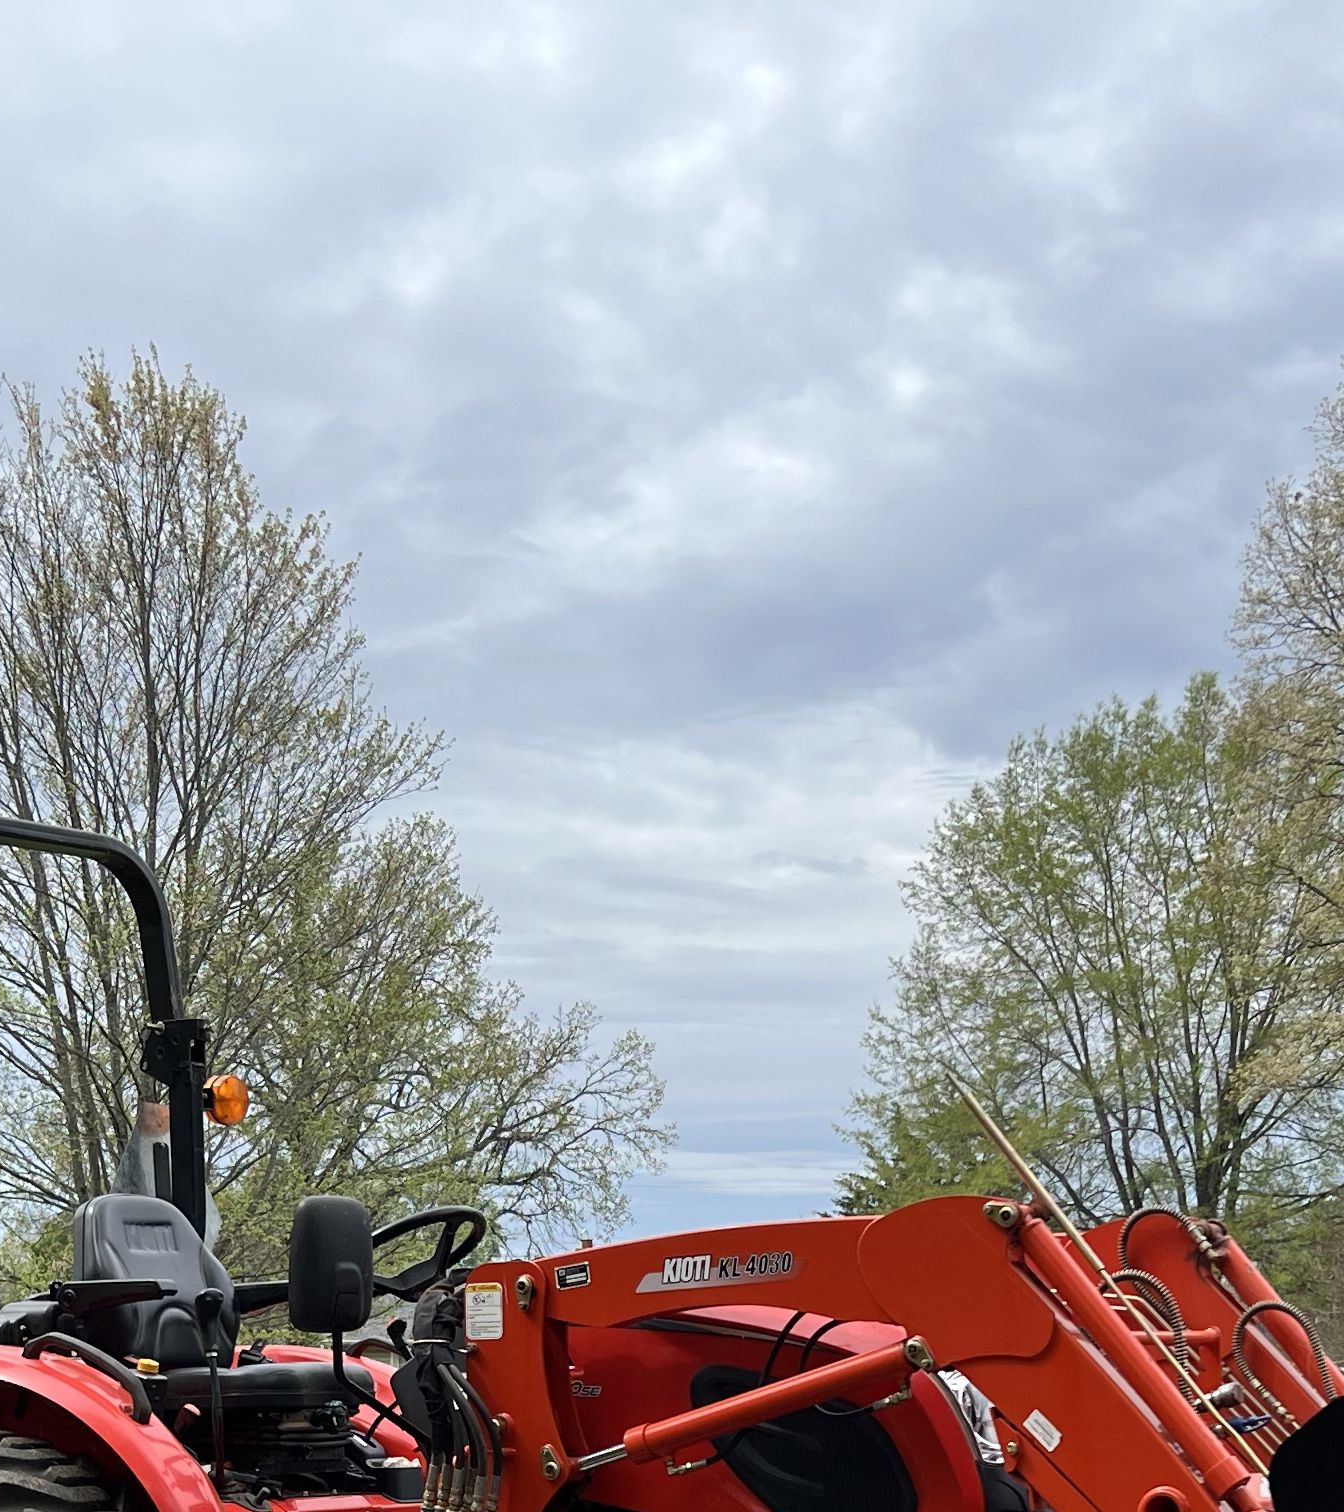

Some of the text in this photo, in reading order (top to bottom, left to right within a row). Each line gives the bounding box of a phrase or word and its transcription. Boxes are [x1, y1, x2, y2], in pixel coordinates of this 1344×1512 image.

[662, 1251, 793, 1285] KIOTI KL 4030
